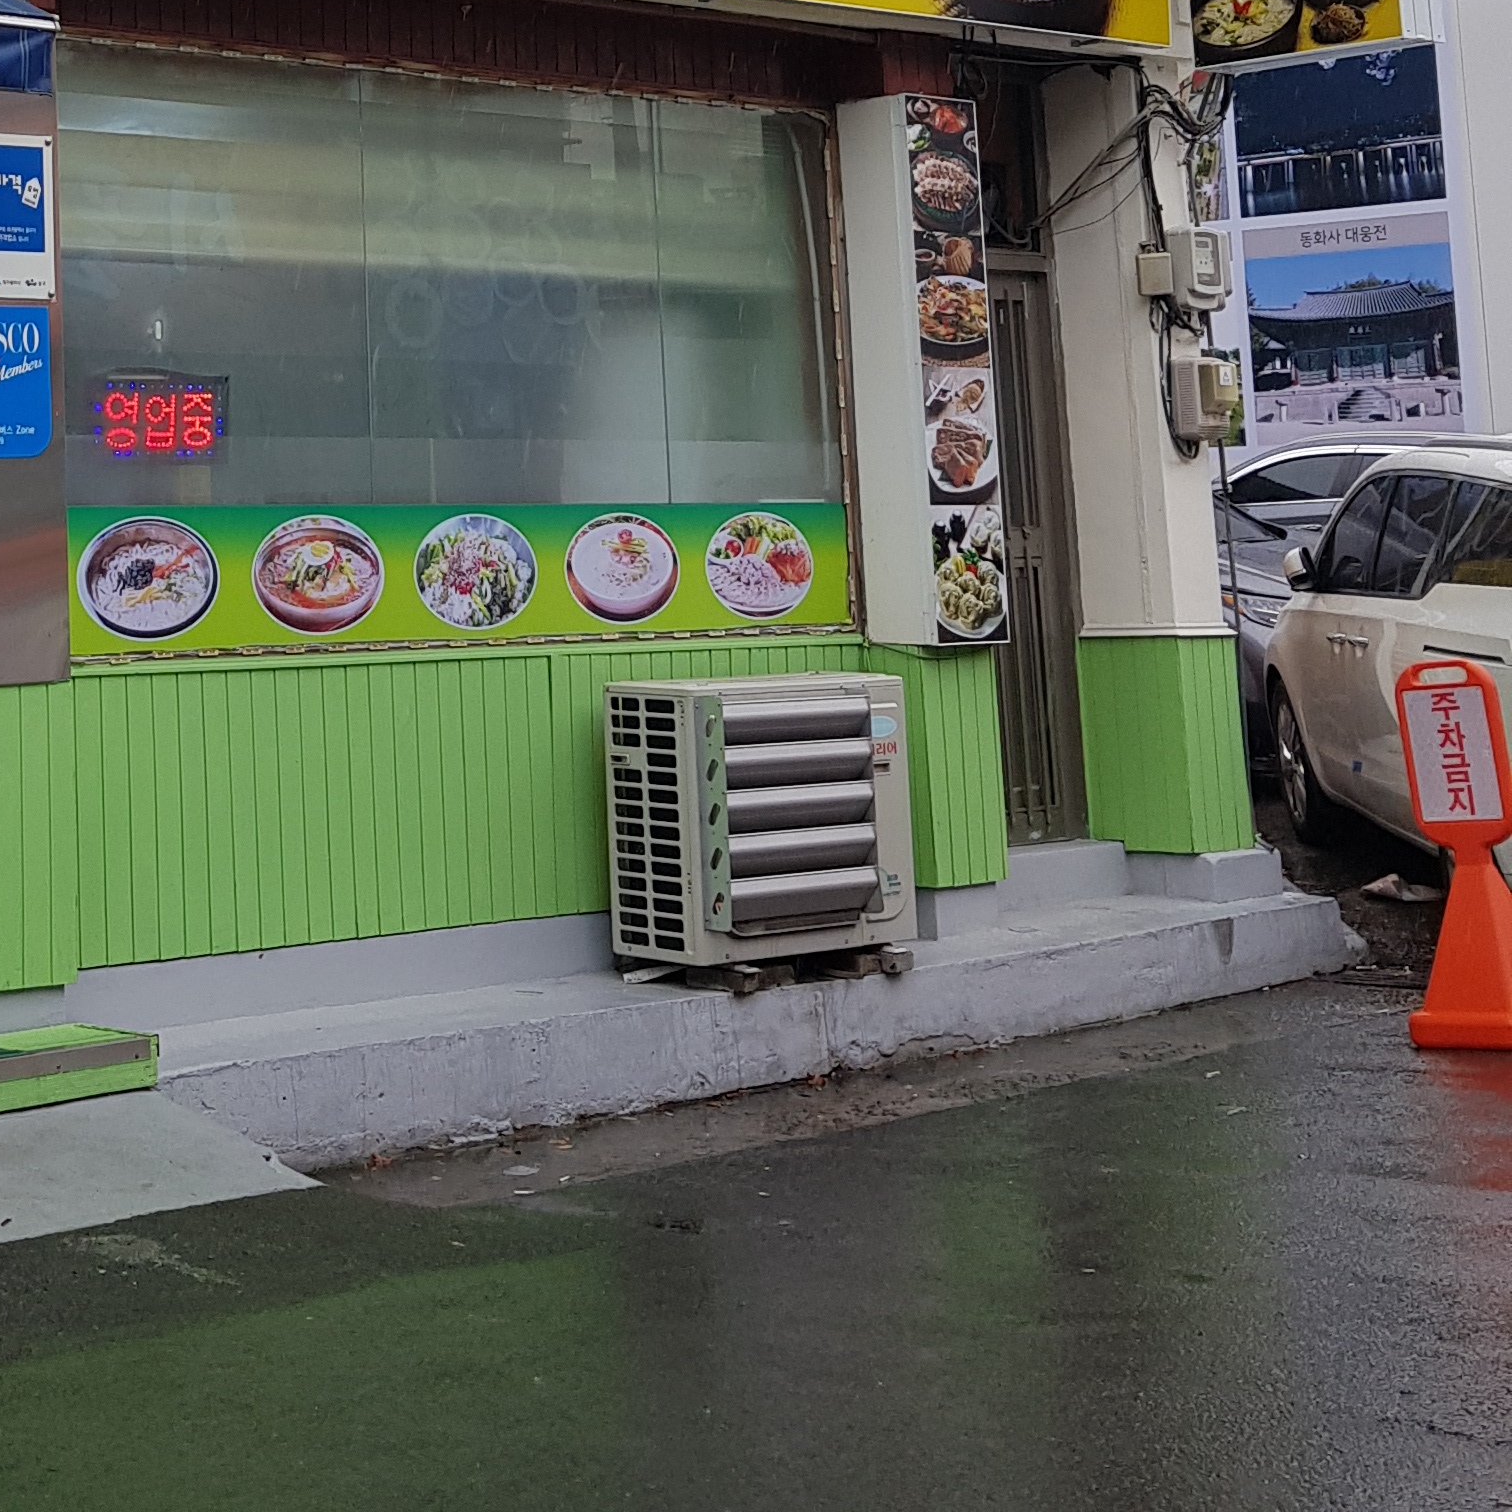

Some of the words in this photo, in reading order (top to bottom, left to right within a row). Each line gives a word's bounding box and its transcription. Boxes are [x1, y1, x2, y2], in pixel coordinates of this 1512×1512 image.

[1299, 226, 1342, 249] 동화사
[1344, 223, 1388, 244] 대웅전
[103, 391, 214, 449] 영업중
[1430, 691, 1477, 816] 주차금지
